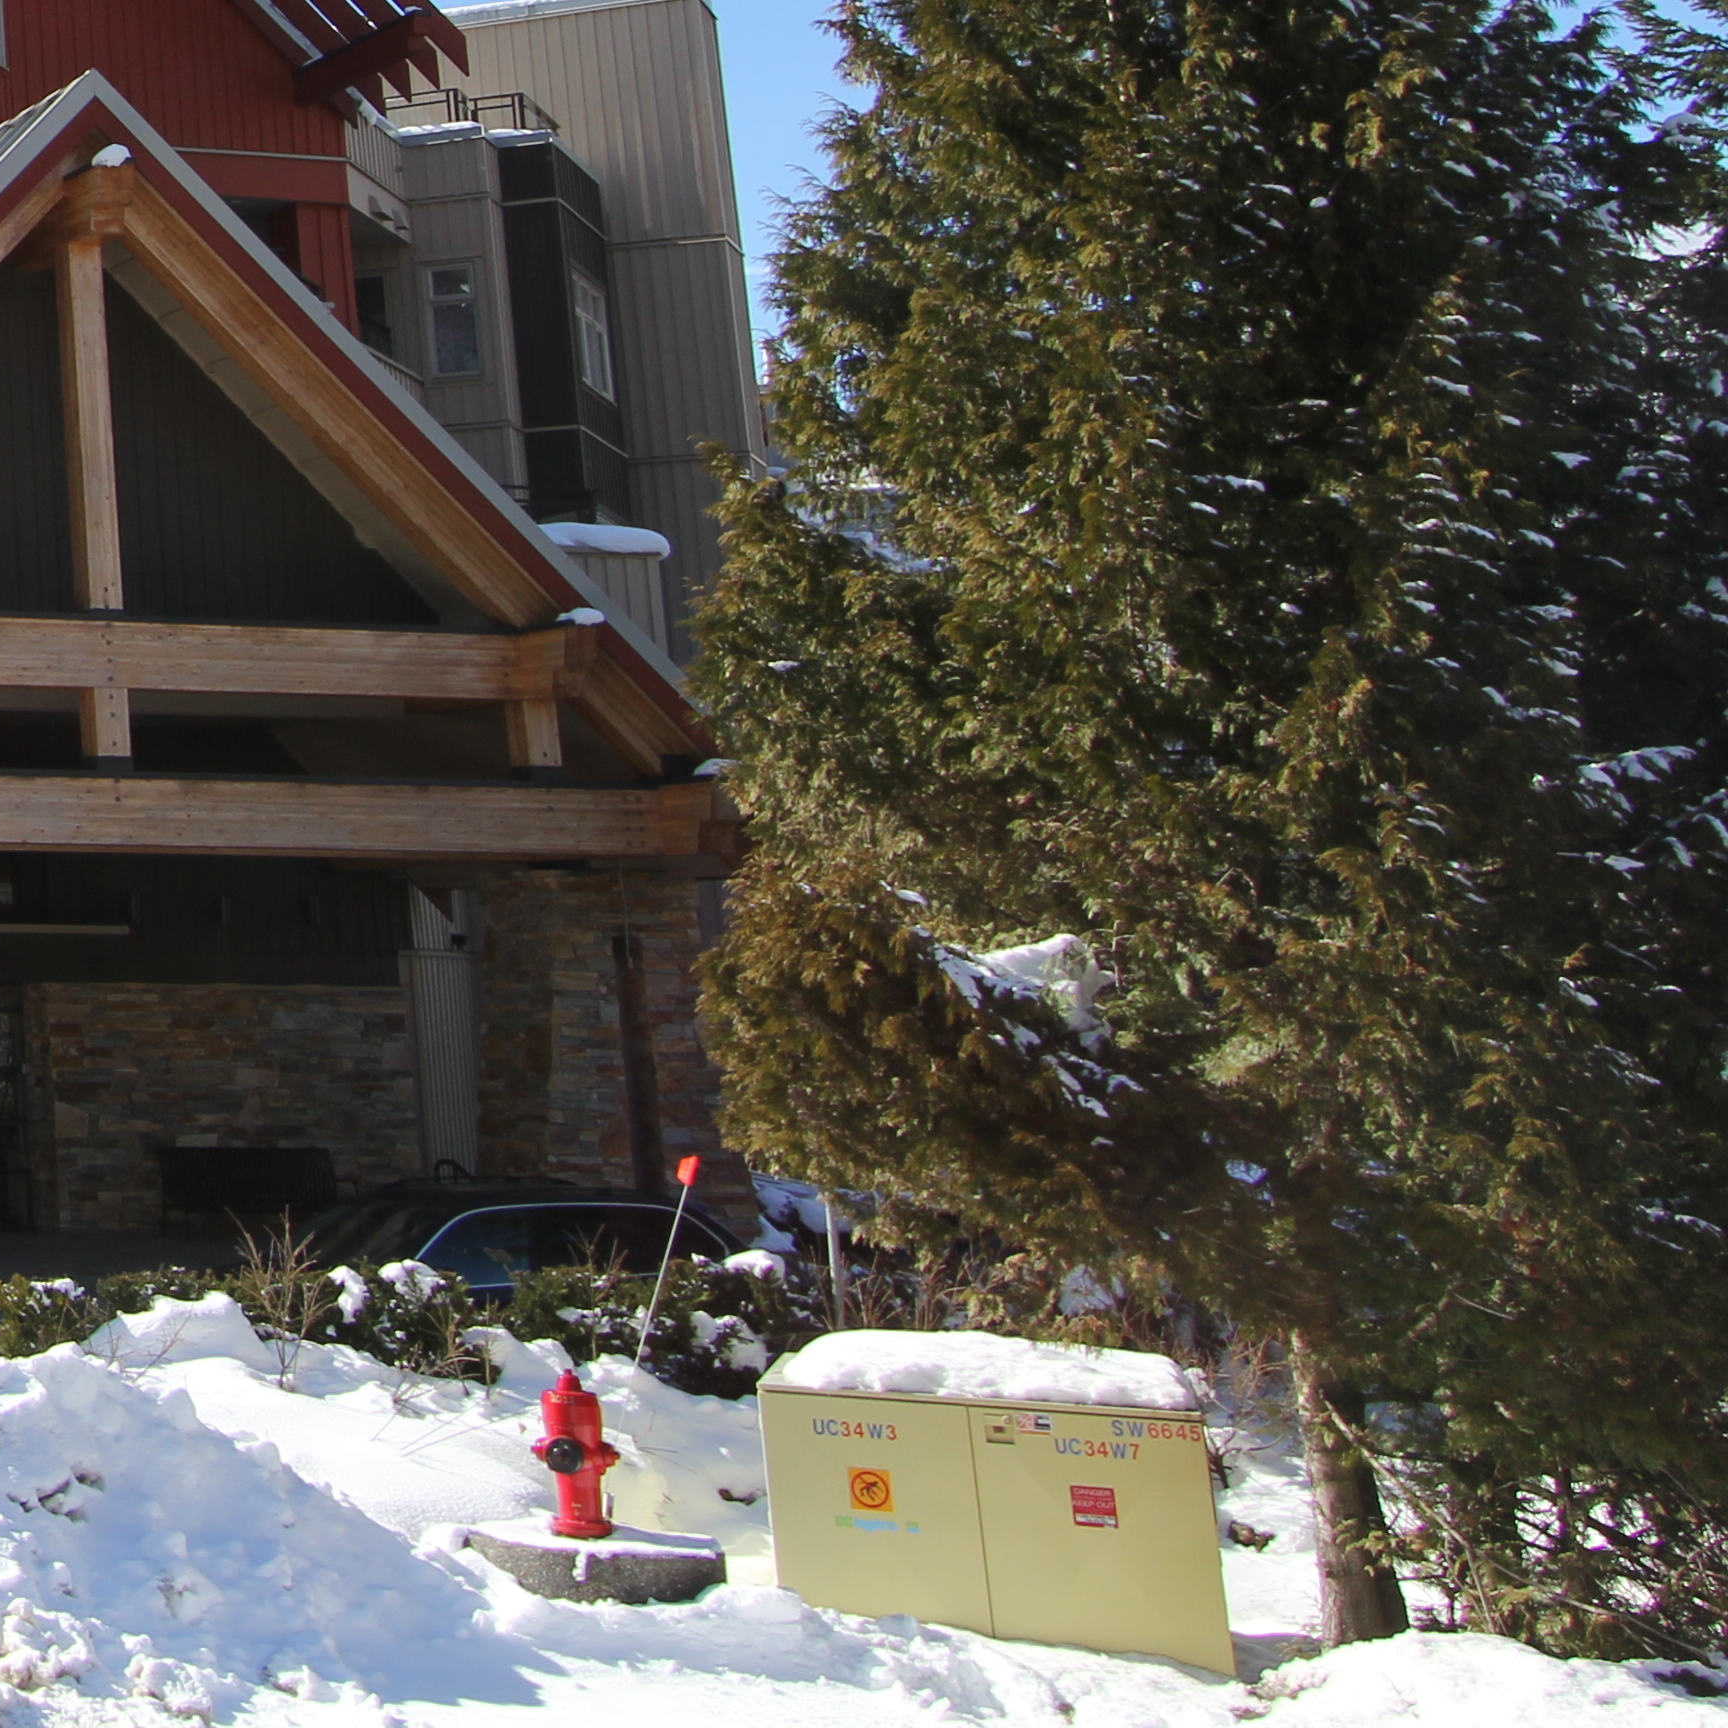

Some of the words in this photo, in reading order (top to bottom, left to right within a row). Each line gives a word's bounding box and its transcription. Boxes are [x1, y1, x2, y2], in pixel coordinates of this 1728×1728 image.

[813, 1418, 897, 1441] UC34W3
[1055, 1438, 1140, 1460] UC34W7
[1073, 1487, 1111, 1497] DANGER
[1073, 1499, 1095, 1508] KEEP
[1096, 1501, 1116, 1509] OUT
